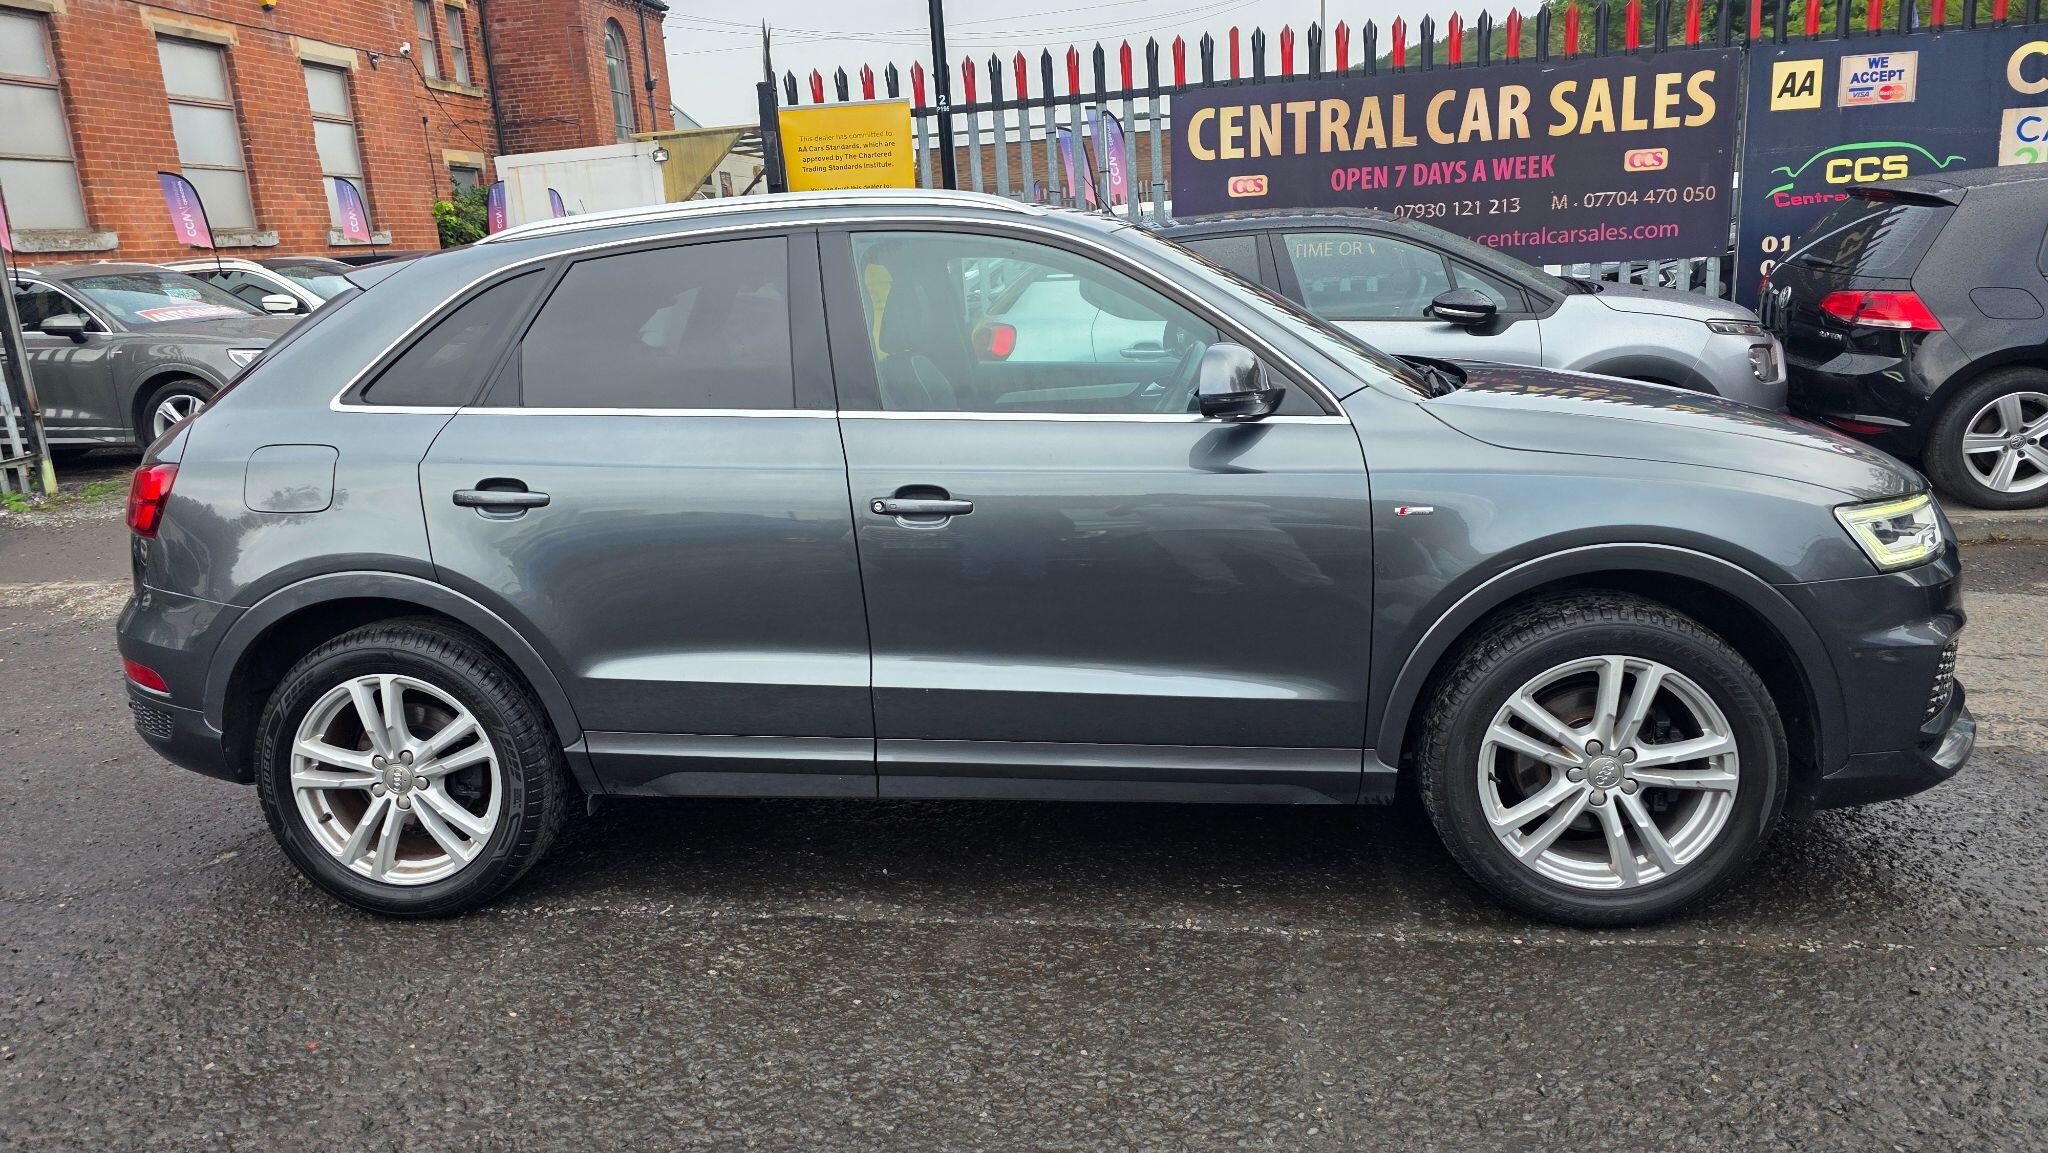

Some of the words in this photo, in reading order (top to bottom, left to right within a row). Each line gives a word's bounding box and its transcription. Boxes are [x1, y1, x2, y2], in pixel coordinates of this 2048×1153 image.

[1868, 56, 1889, 69] WE
[1777, 70, 1815, 98] AA
[1850, 69, 1905, 84] ACCEPT
[939, 94, 946, 105] 2
[1188, 93, 1418, 160] CENTRAL
[1426, 85, 1531, 145] CAR
[1548, 69, 1717, 136] SALES
[848, 130, 883, 139] committed
[2016, 115, 2048, 142] C
[825, 142, 861, 151] Standards,
[863, 141, 882, 149] which
[802, 154, 833, 163] approved
[835, 154, 843, 162] by
[858, 150, 892, 159] Chartered
[1628, 151, 1664, 168] CCS
[802, 165, 827, 173] Trading
[828, 162, 862, 171] Standards
[863, 161, 894, 169] Institute.
[1331, 165, 1388, 191] OPEN
[1394, 165, 1408, 188] 7
[1413, 160, 1467, 186] DAYS
[1471, 158, 1487, 182] A
[1492, 153, 1557, 181] WEEK
[1825, 154, 1908, 184] CCS
[1232, 177, 1265, 195] CCS
[1582, 190, 1638, 208] 07704
[1643, 187, 1676, 204] 470
[1682, 185, 1715, 203] 050
[1773, 191, 1849, 208] Centra
[1394, 202, 1446, 219] 07930
[1453, 201, 1481, 216] 121
[1488, 197, 1521, 214] 213
[1467, 222, 1680, 248] centralcarsales.com
[1339, 240, 1362, 256] OR
